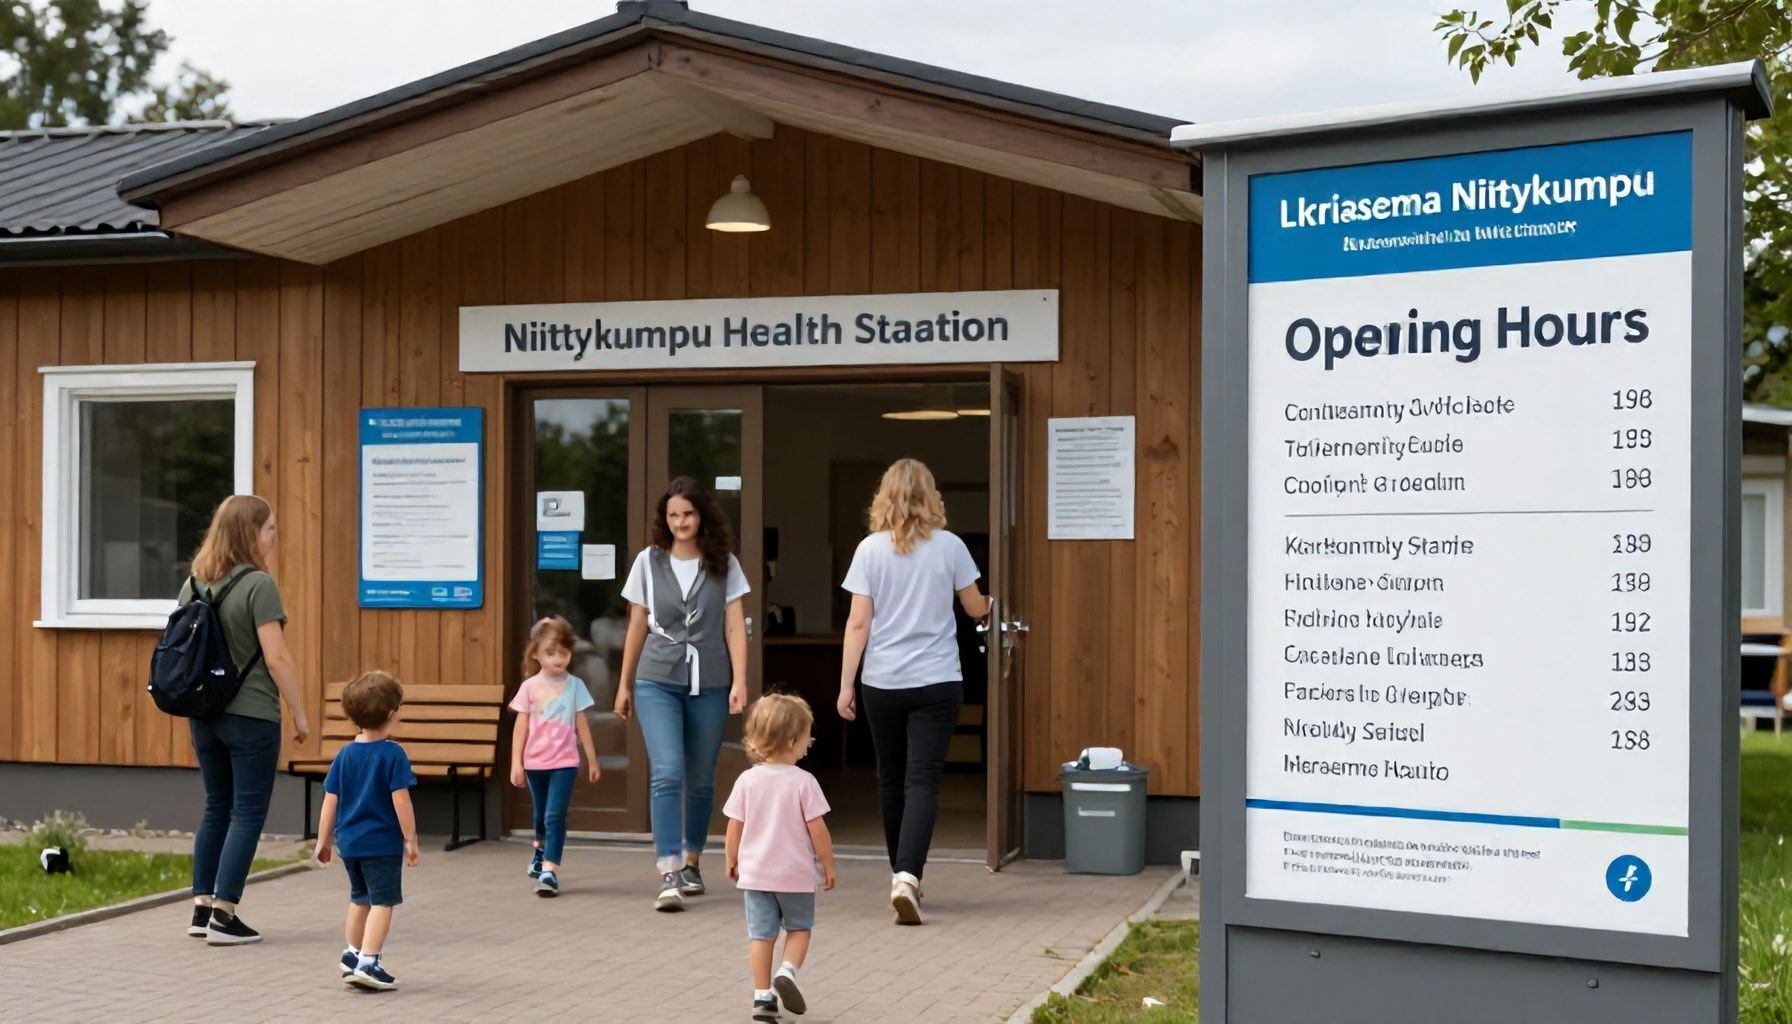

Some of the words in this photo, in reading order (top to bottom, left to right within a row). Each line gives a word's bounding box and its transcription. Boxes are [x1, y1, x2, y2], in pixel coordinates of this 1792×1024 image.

[504, 318, 712, 362] Niittykumpu
[723, 312, 843, 347] Health
[854, 309, 1009, 345] Staation
[1497, 305, 1650, 350] Hours
[1611, 611, 1652, 633] 192
